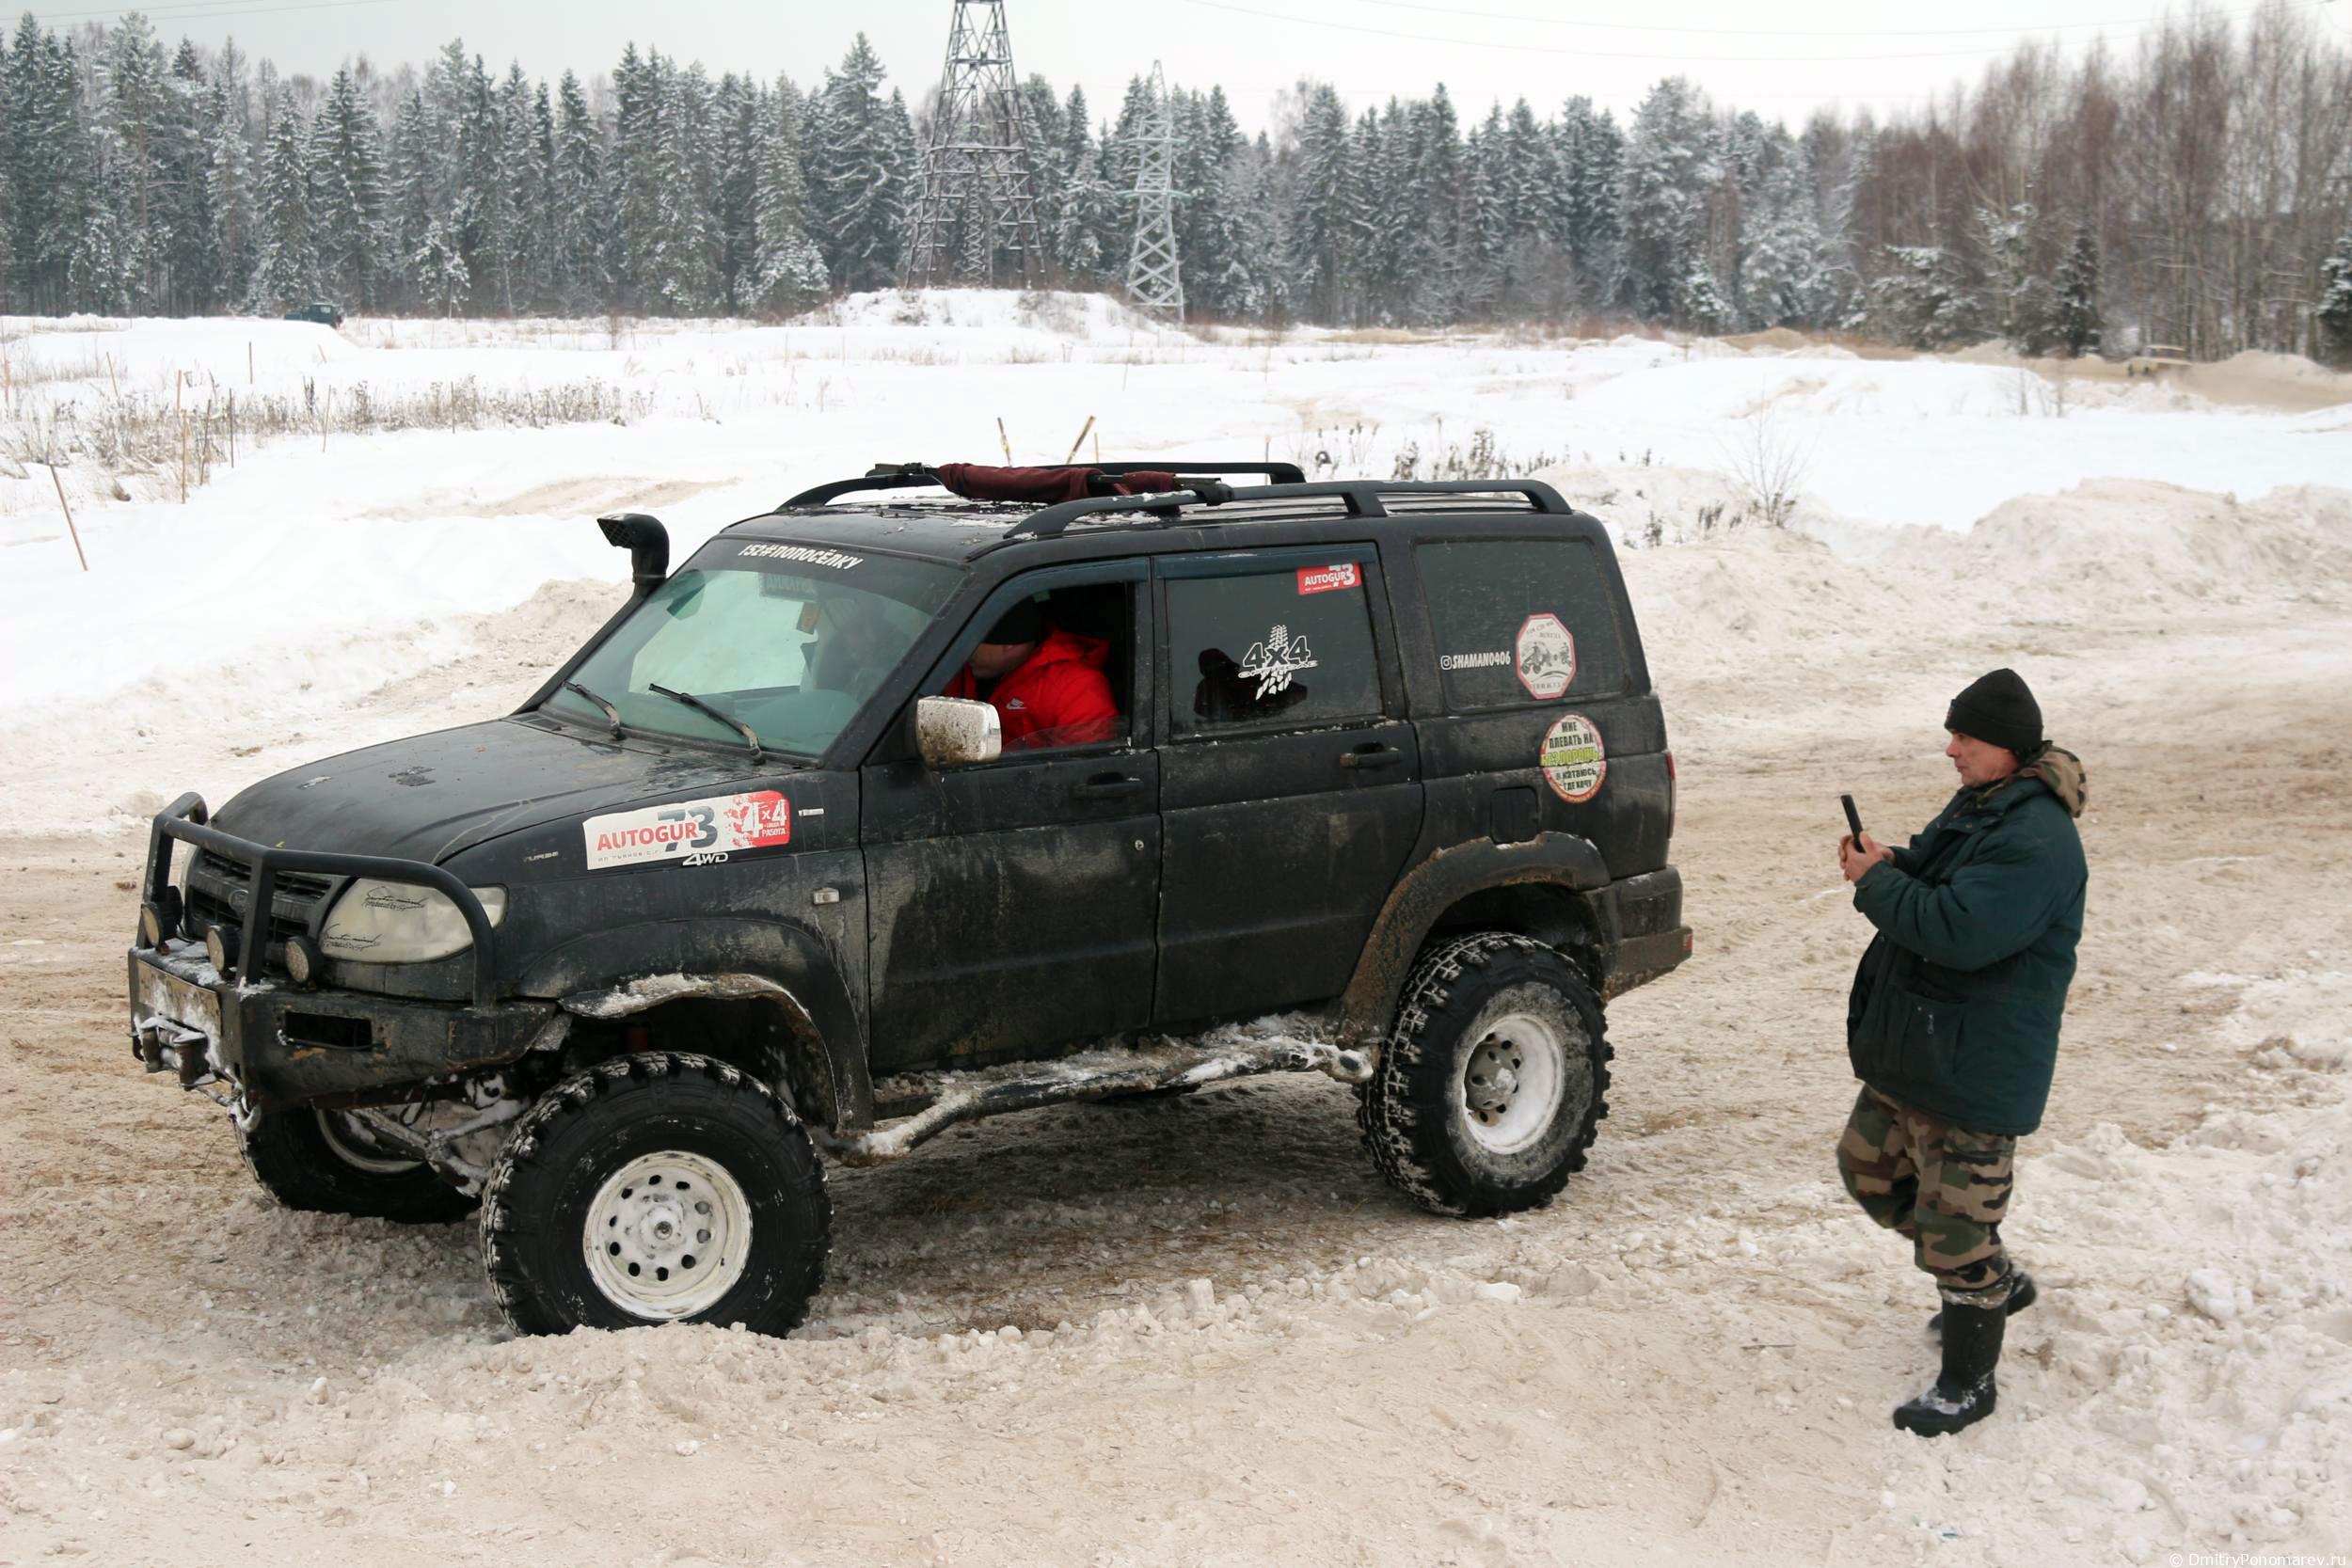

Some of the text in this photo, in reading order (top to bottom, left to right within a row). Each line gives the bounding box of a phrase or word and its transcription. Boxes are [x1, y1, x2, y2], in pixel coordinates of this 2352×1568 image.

[1304, 570, 1346, 587] AUTOGUR
[1562, 721, 1578, 733] МНЕ
[1549, 732, 1594, 749] ПЛЕВАТЬ НА
[596, 820, 698, 851] AUTOGUR
[682, 852, 728, 866] 4WD
